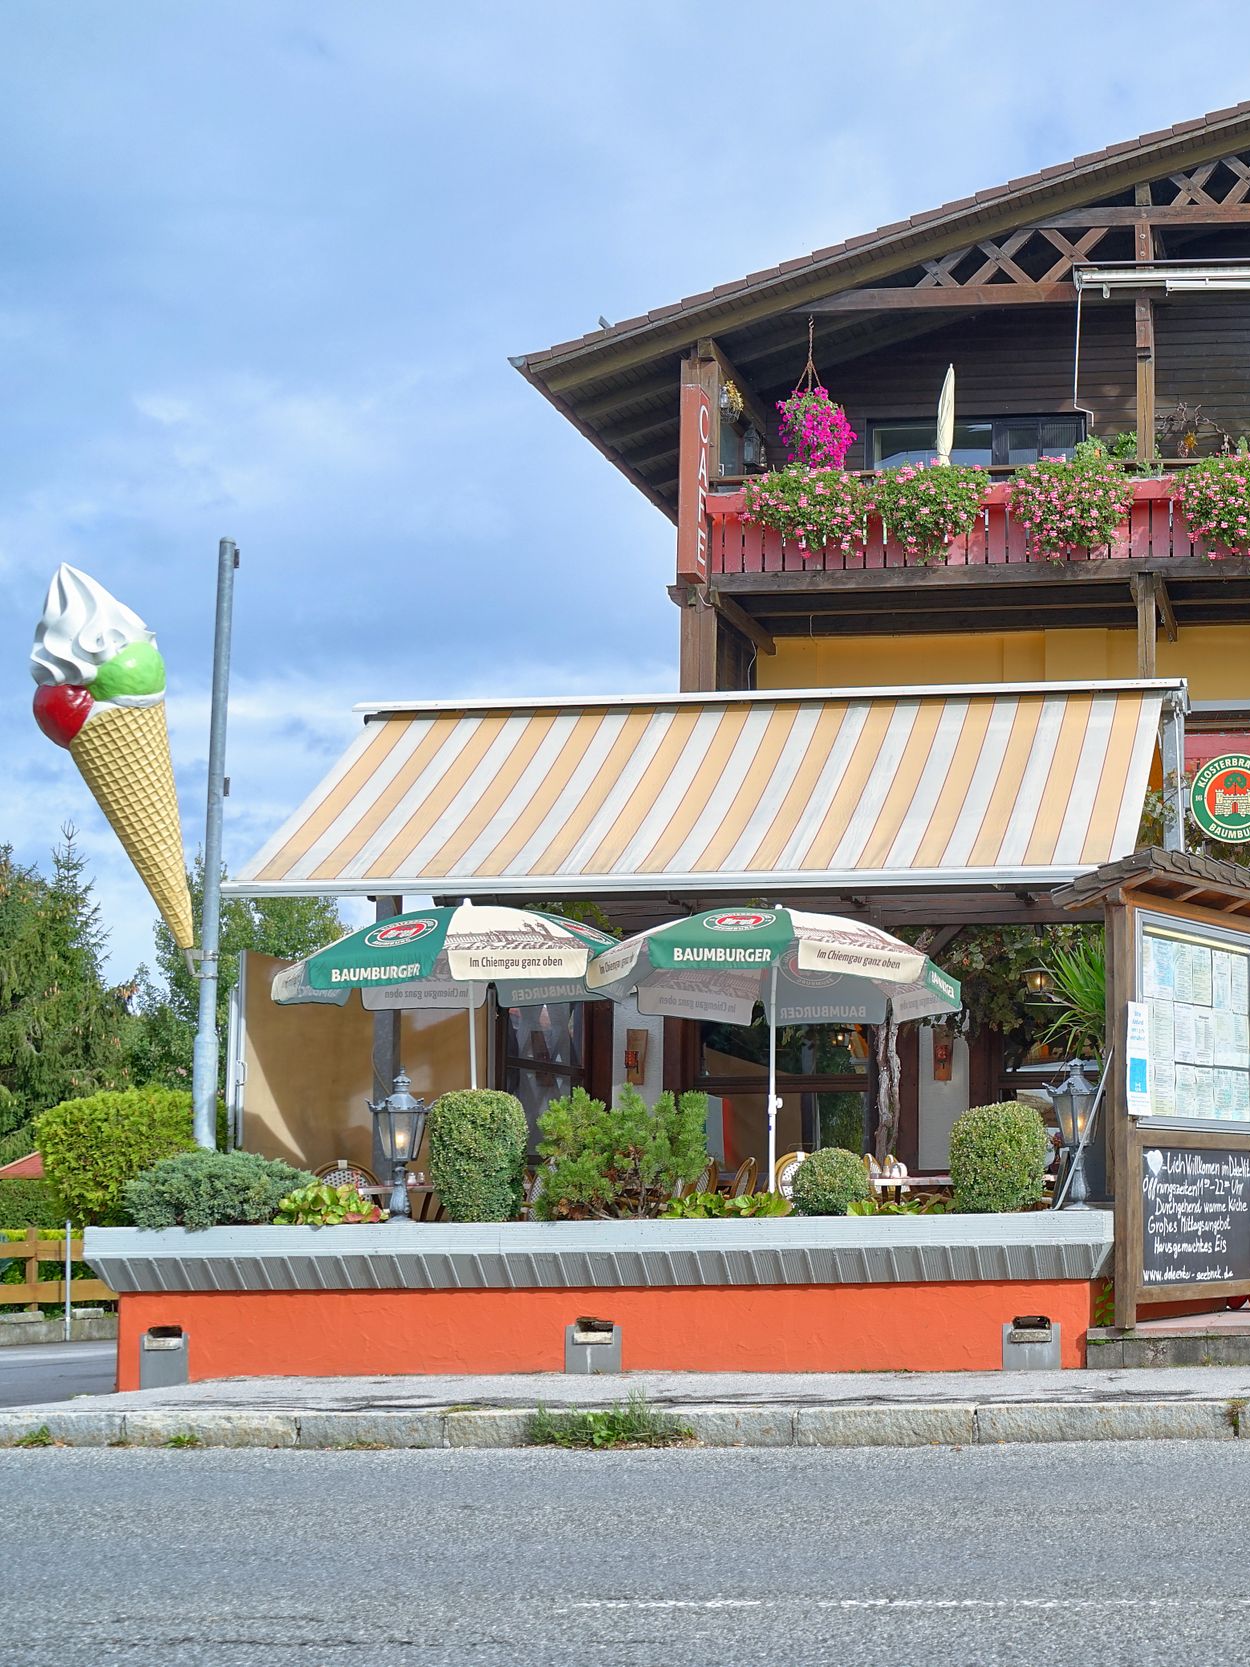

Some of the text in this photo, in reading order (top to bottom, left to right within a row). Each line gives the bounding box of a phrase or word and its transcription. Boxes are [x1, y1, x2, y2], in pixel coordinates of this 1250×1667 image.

[697, 404, 709, 567] CAFE
[469, 956, 563, 970] Im Chiemgau ganz oben
[673, 947, 772, 962] BAUMBURGER
[816, 948, 901, 969] Im Chiemgau ganz oben
[331, 963, 421, 982] BAUMBURGER
[1214, 1234, 1227, 1253] Eis
